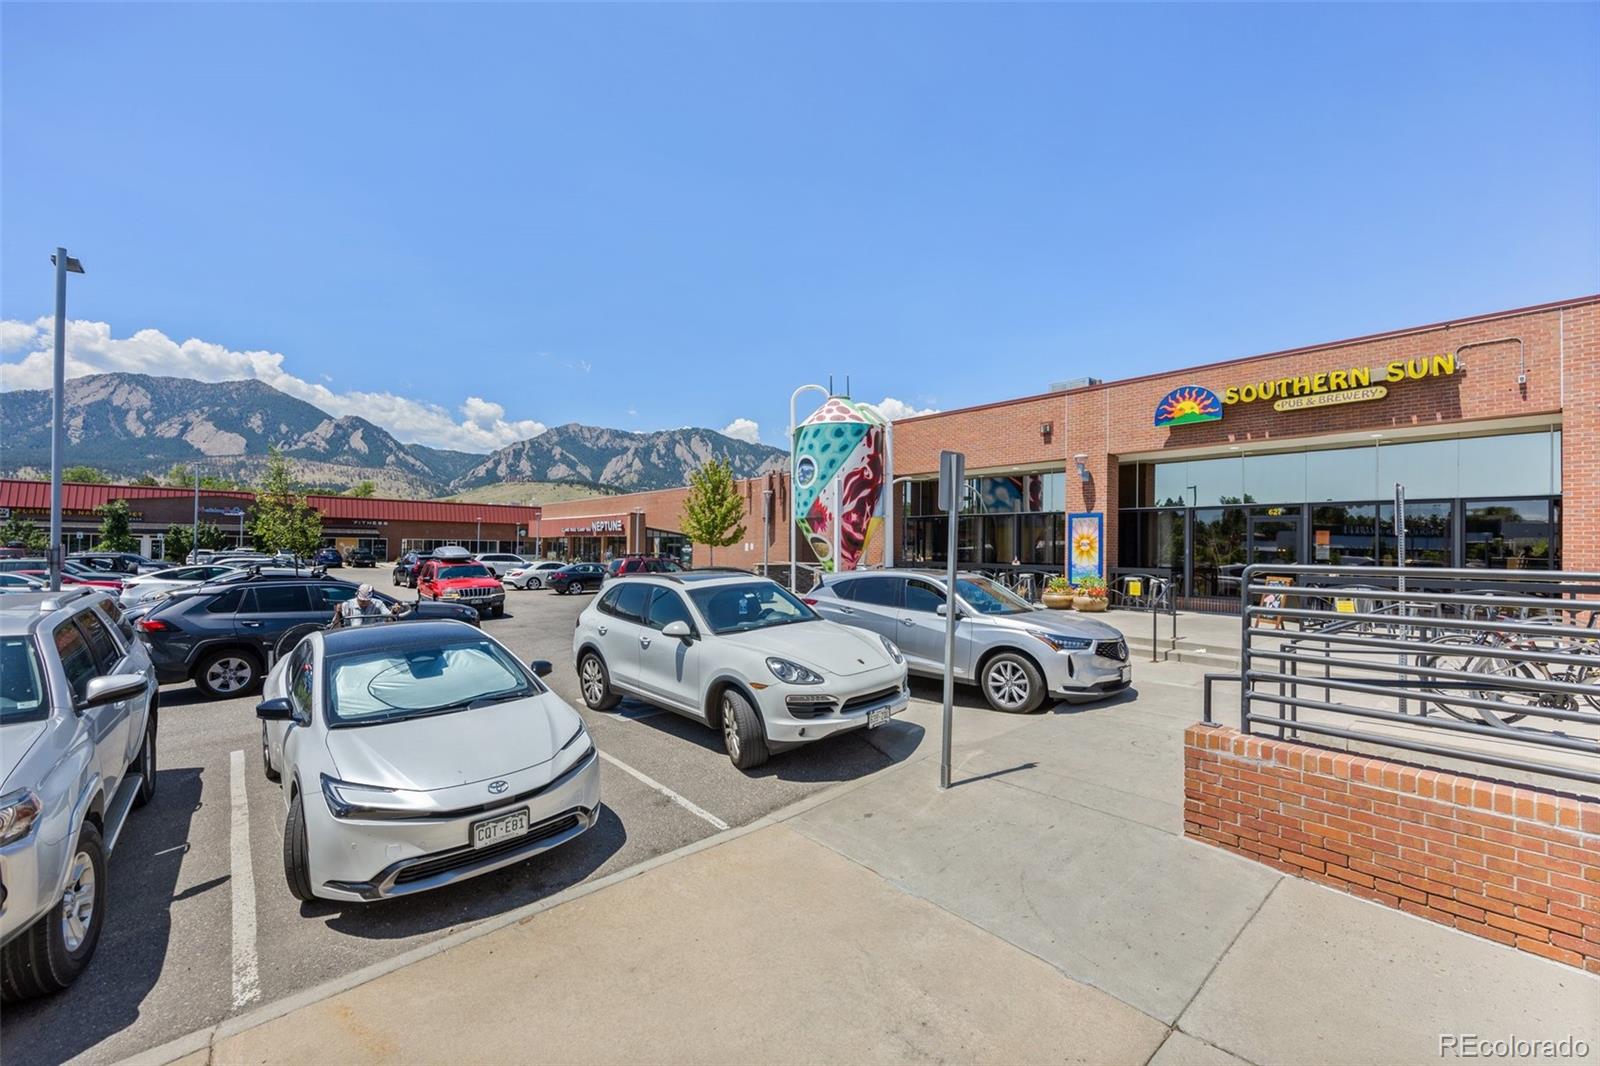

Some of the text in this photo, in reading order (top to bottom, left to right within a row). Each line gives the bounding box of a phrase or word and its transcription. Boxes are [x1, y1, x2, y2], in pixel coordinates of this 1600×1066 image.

[1225, 353, 1455, 405] SOUTHERN SUN
[1281, 388, 1378, 410] PUB & BREWERY
[592, 520, 622, 532] NEPTUNE
